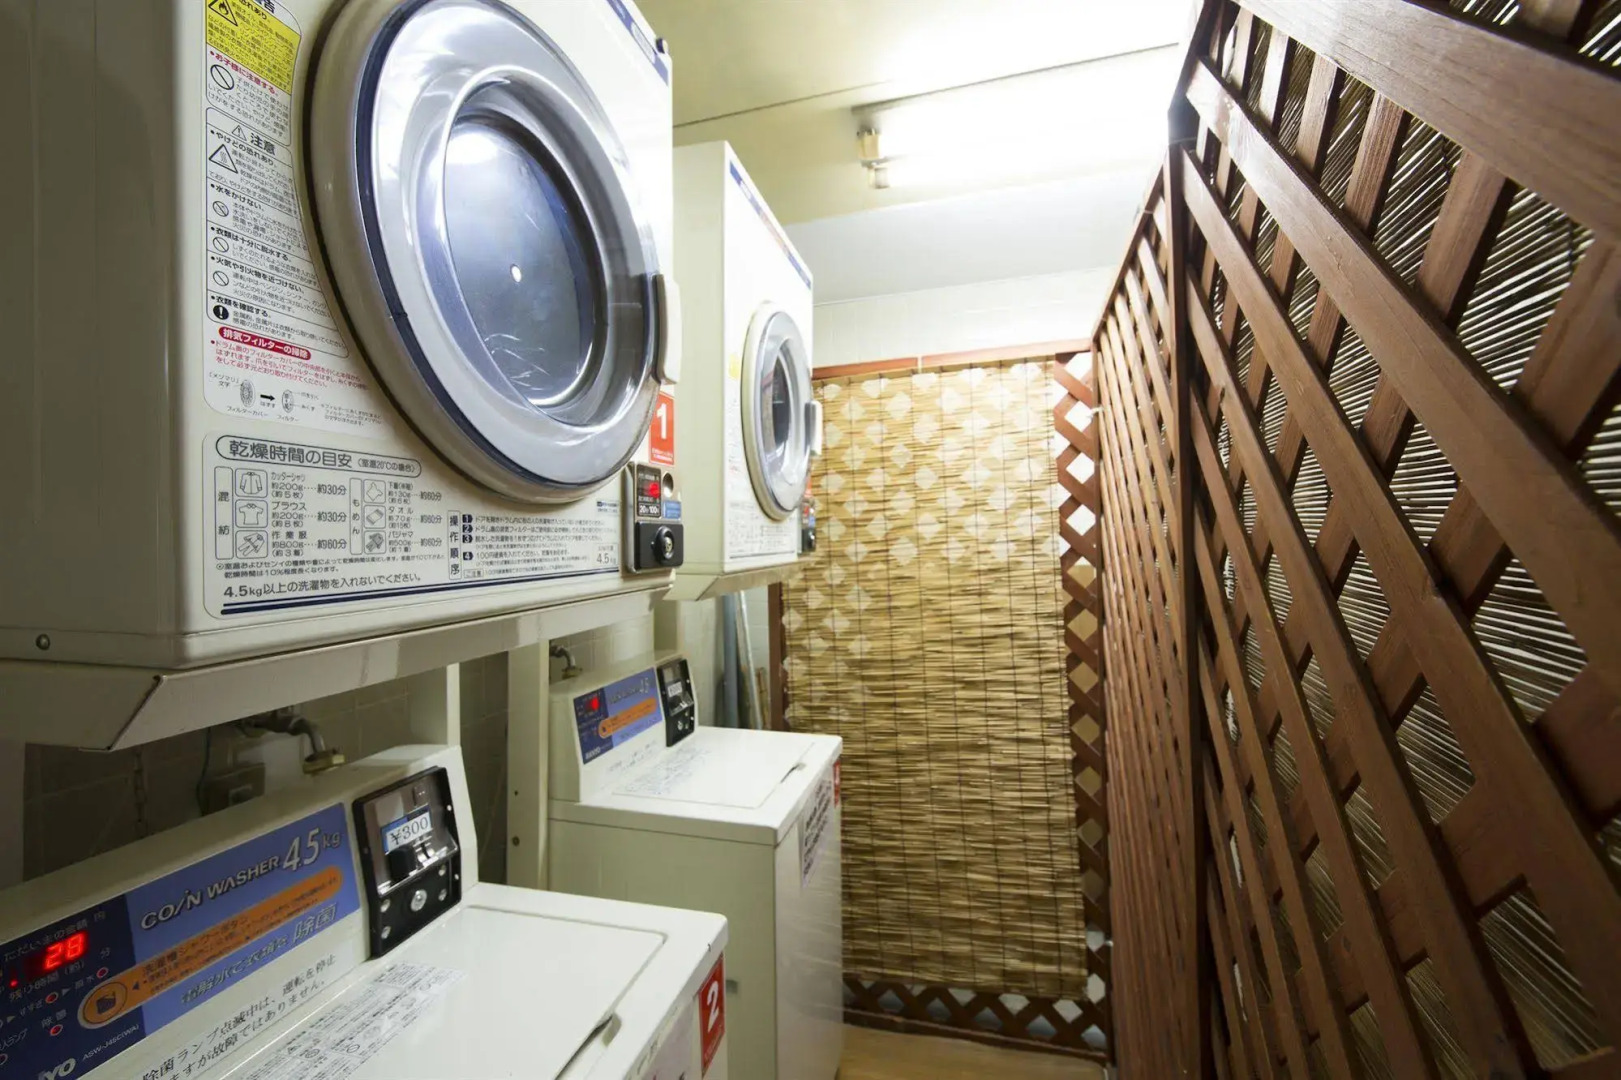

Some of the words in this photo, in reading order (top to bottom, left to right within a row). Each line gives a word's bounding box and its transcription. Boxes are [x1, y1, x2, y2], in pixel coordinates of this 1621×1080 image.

[216, 131, 277, 167] やけどの恐れあり。
[250, 132, 276, 155] 注意
[216, 184, 264, 211] 水をかけない。
[216, 227, 293, 262] 衣類は十分に脱水する。
[216, 256, 304, 294] 火気や引火物を近づけない。
[216, 295, 272, 318] 衣類を確認する。
[223, 327, 308, 359] 排気フィルターの掃除
[657, 403, 667, 439] 1
[229, 440, 352, 468] 乾燥時間の目安
[317, 484, 347, 496] 約30分
[272, 502, 307, 510] ブラウス
[317, 512, 347, 523] 約30分
[317, 539, 347, 549] 約60分
[449, 514, 460, 576] 操作順序
[389, 815, 430, 846] ¥300
[140, 889, 202, 930] COIN
[206, 855, 283, 899] WASHER
[44, 930, 88, 971] 28
[706, 980, 719, 1033] 2
